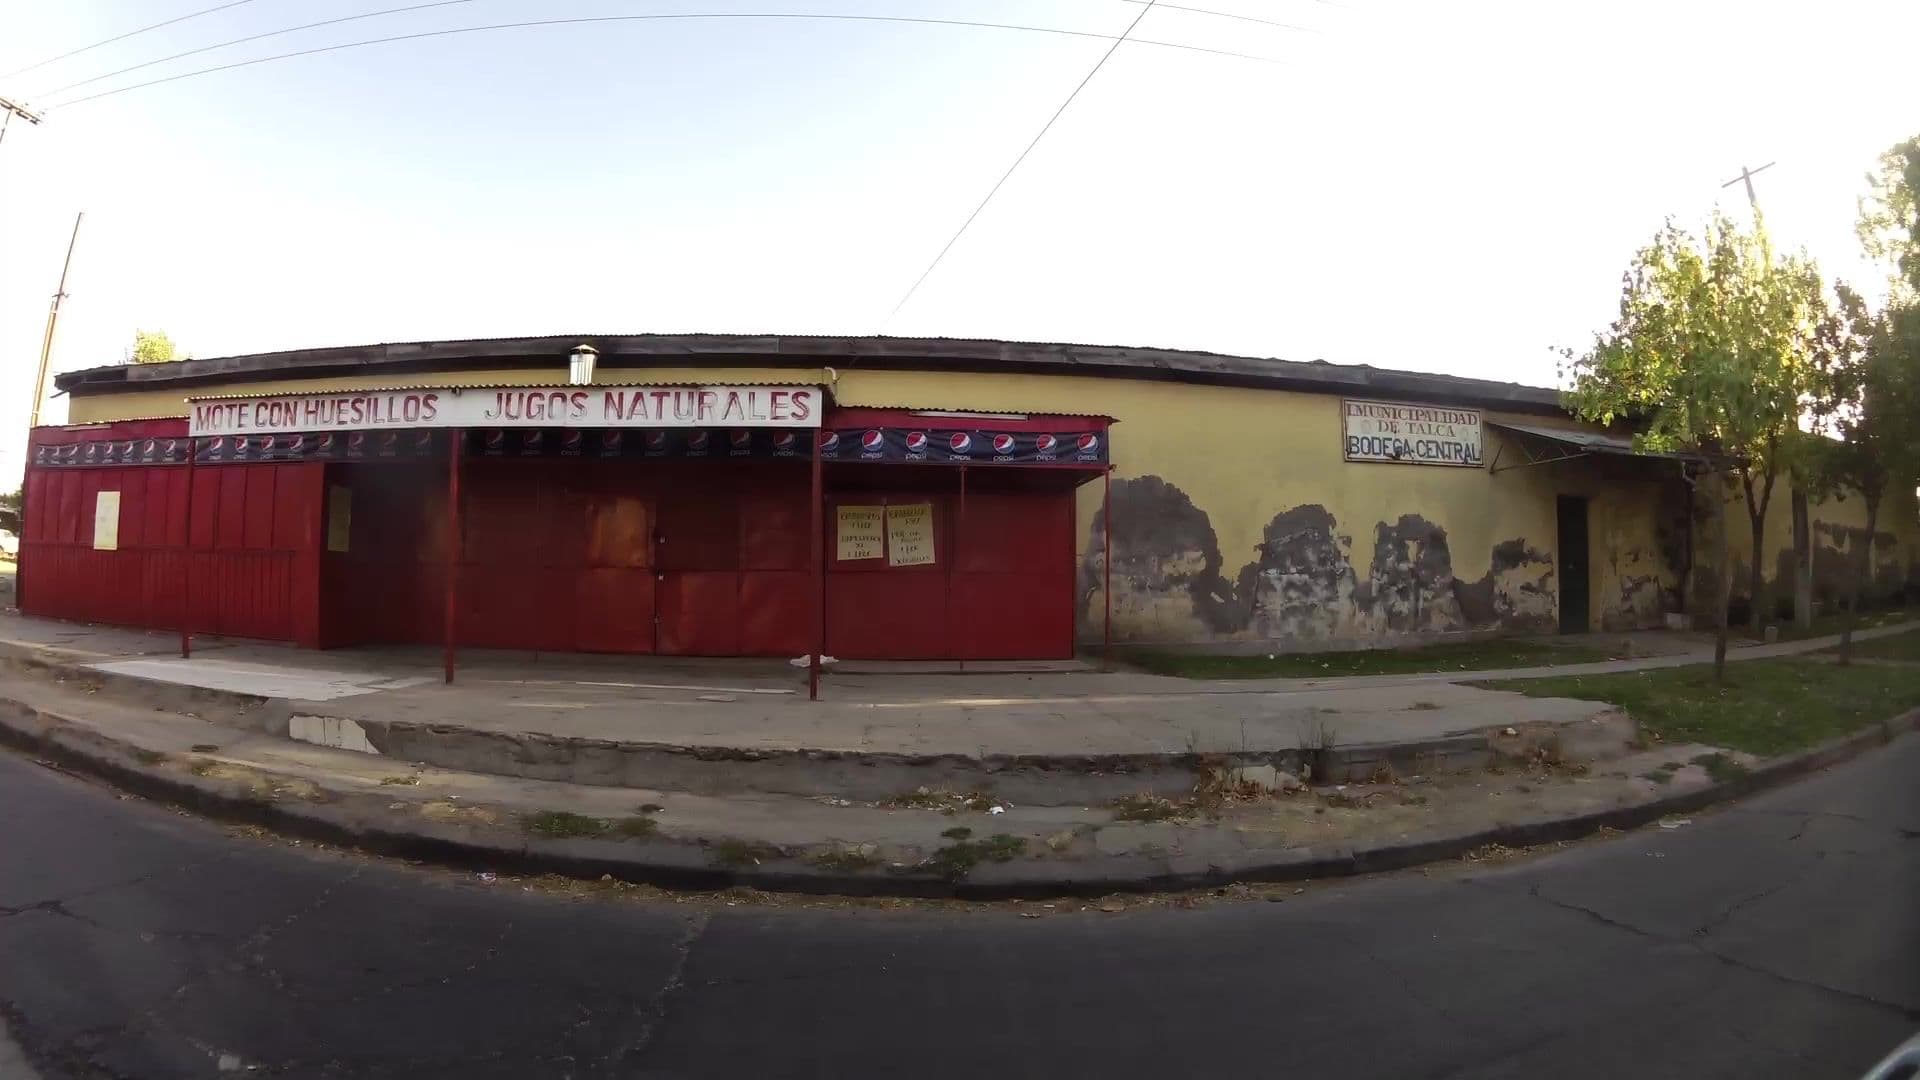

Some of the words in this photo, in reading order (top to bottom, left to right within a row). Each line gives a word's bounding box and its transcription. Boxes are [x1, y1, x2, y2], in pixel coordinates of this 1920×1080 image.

[195, 402, 249, 431] MOTE
[255, 400, 297, 428] CON
[303, 393, 440, 426] HUESILLOS
[484, 390, 589, 421] JUGOS
[604, 390, 812, 421] NATURALES
[1377, 420, 1400, 433] DE
[1405, 421, 1457, 438] TALCA
[1416, 439, 1481, 461] CENTRAL
